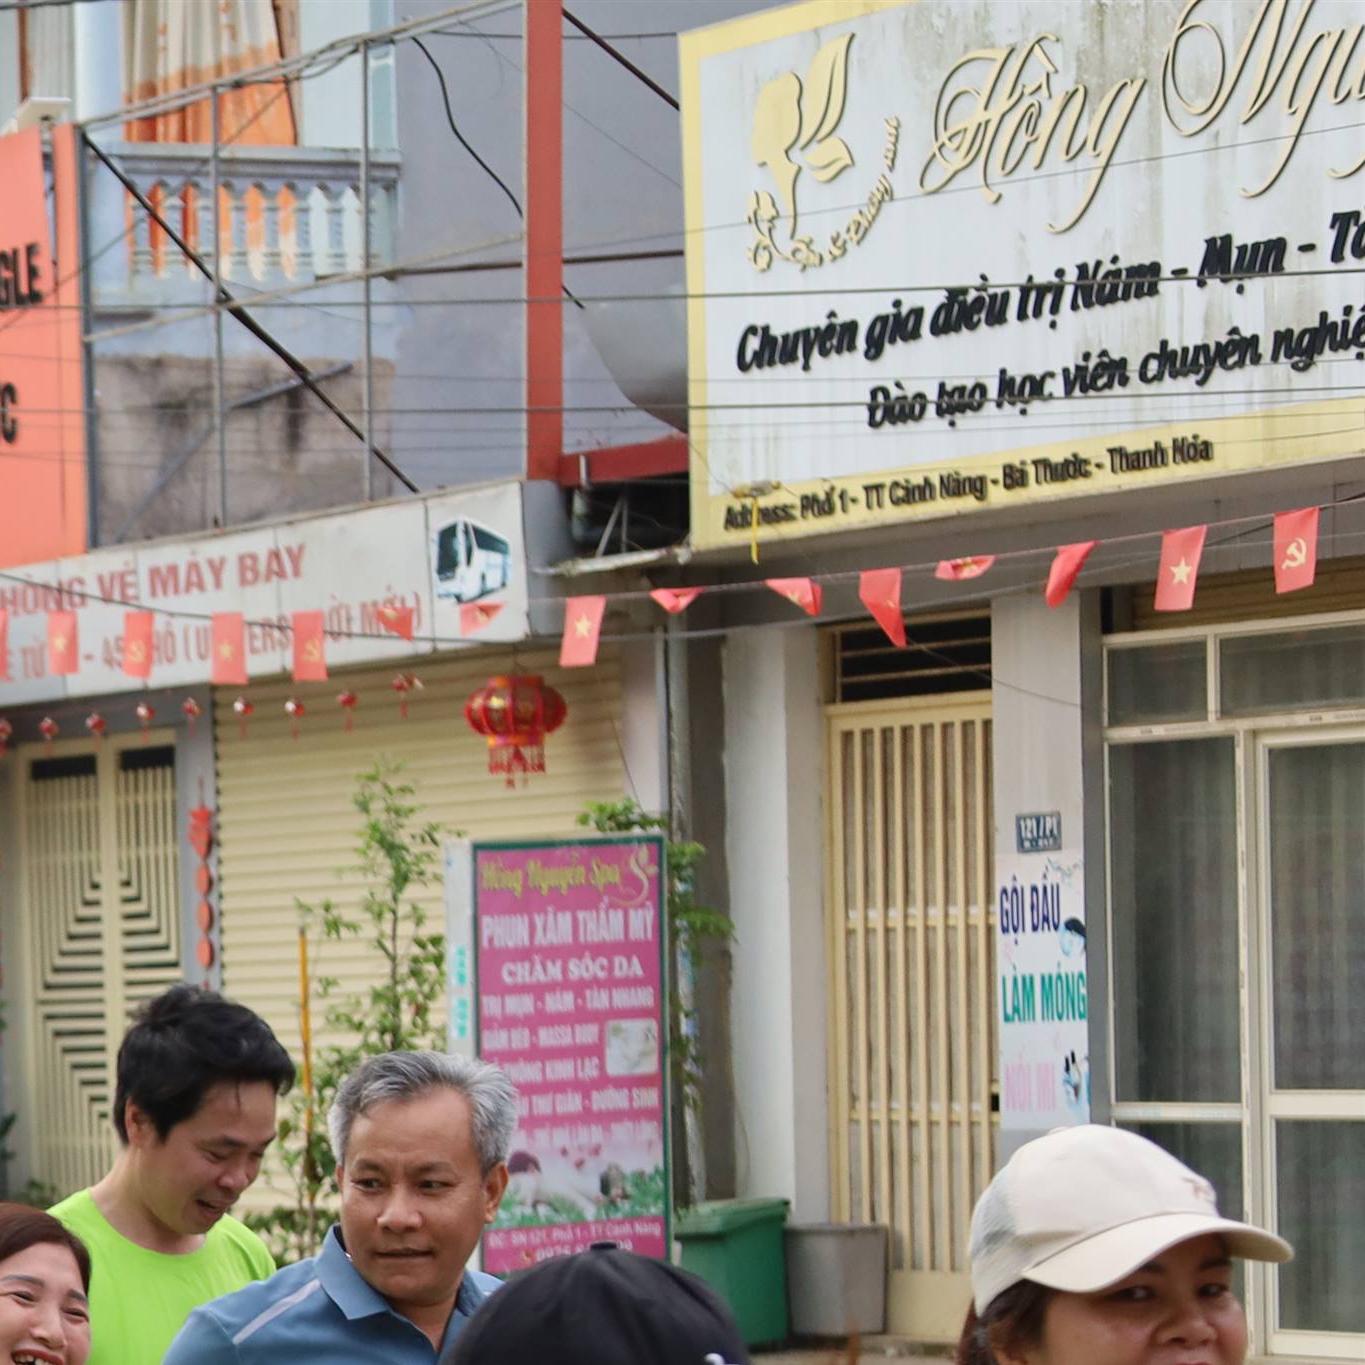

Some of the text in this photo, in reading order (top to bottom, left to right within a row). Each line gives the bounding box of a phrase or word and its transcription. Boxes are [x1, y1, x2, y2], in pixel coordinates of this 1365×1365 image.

[919, 33, 1147, 233] Hồng
[736, 309, 859, 373] Chuyên
[864, 298, 925, 361] gia
[929, 272, 1010, 337] điều
[1016, 267, 1066, 330] trị
[1069, 254, 1162, 312] Nám
[1195, 233, 1288, 295] Mụn
[866, 379, 929, 429] Đào
[935, 380, 988, 429] tạo
[995, 366, 1056, 417] học
[1061, 348, 1130, 398] viên
[1137, 325, 1262, 386] chuyên
[863, 482, 886, 510] TT
[1105, 441, 1168, 474] Thanh
[236, 542, 308, 588] BAY
[481, 914, 530, 948] PHUN
[999, 865, 1061, 946] GỘI ĐẦU
[568, 951, 609, 981] SÓC
[612, 954, 645, 979] DA
[1001, 961, 1087, 1024] LÀM MÓNG
